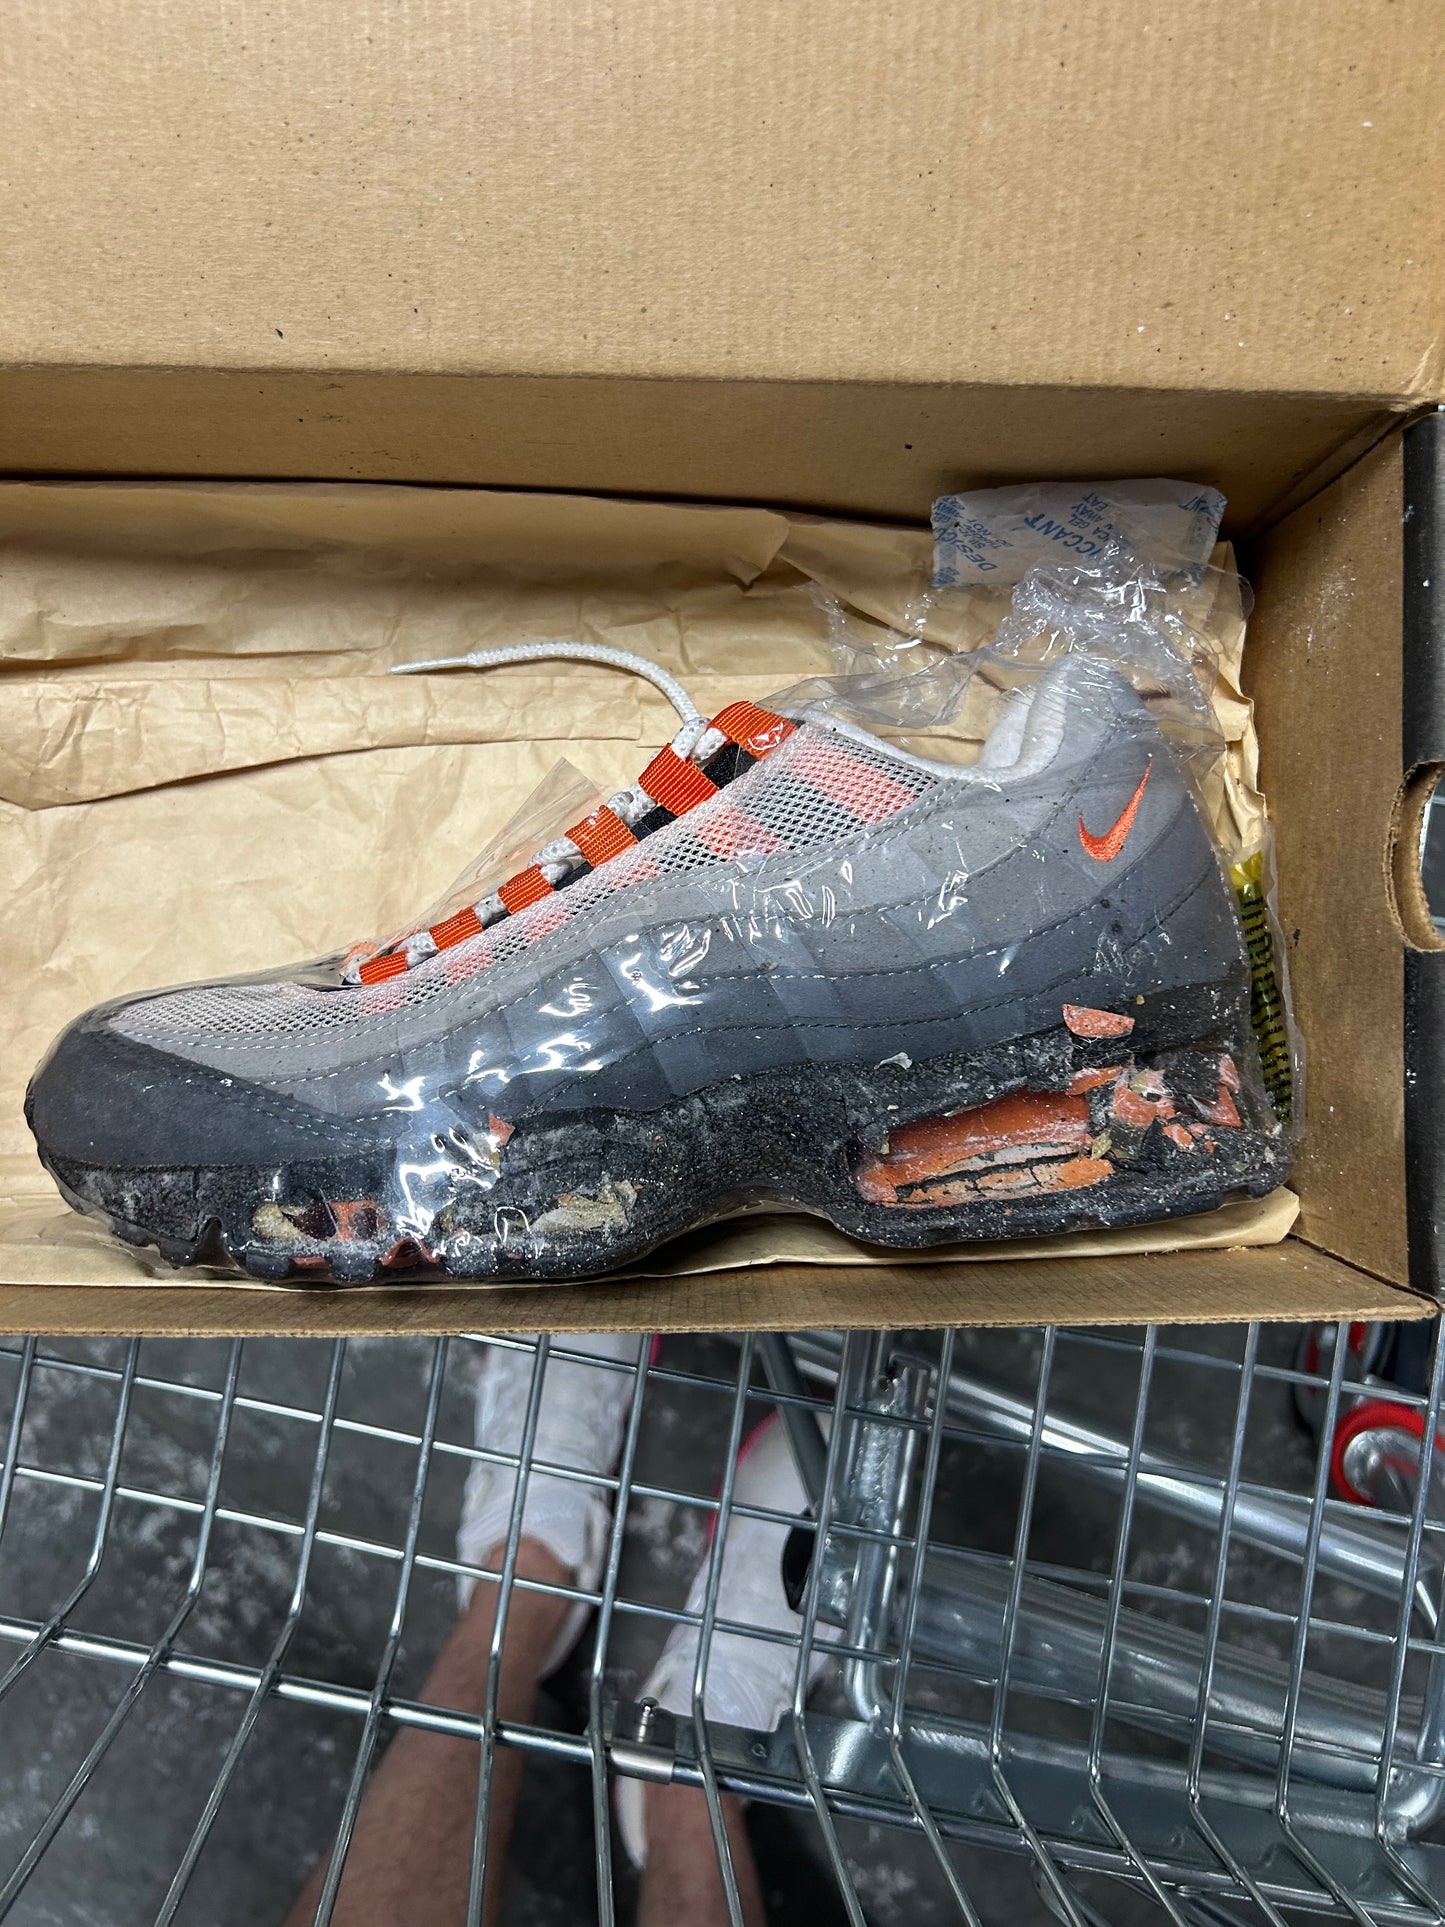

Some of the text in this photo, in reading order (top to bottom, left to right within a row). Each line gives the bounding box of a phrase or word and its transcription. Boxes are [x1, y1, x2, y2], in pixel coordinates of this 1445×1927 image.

[1082, 492, 1108, 512] EAT
[1068, 513, 1090, 530] GEL
[1071, 503, 1104, 523] AWAY
